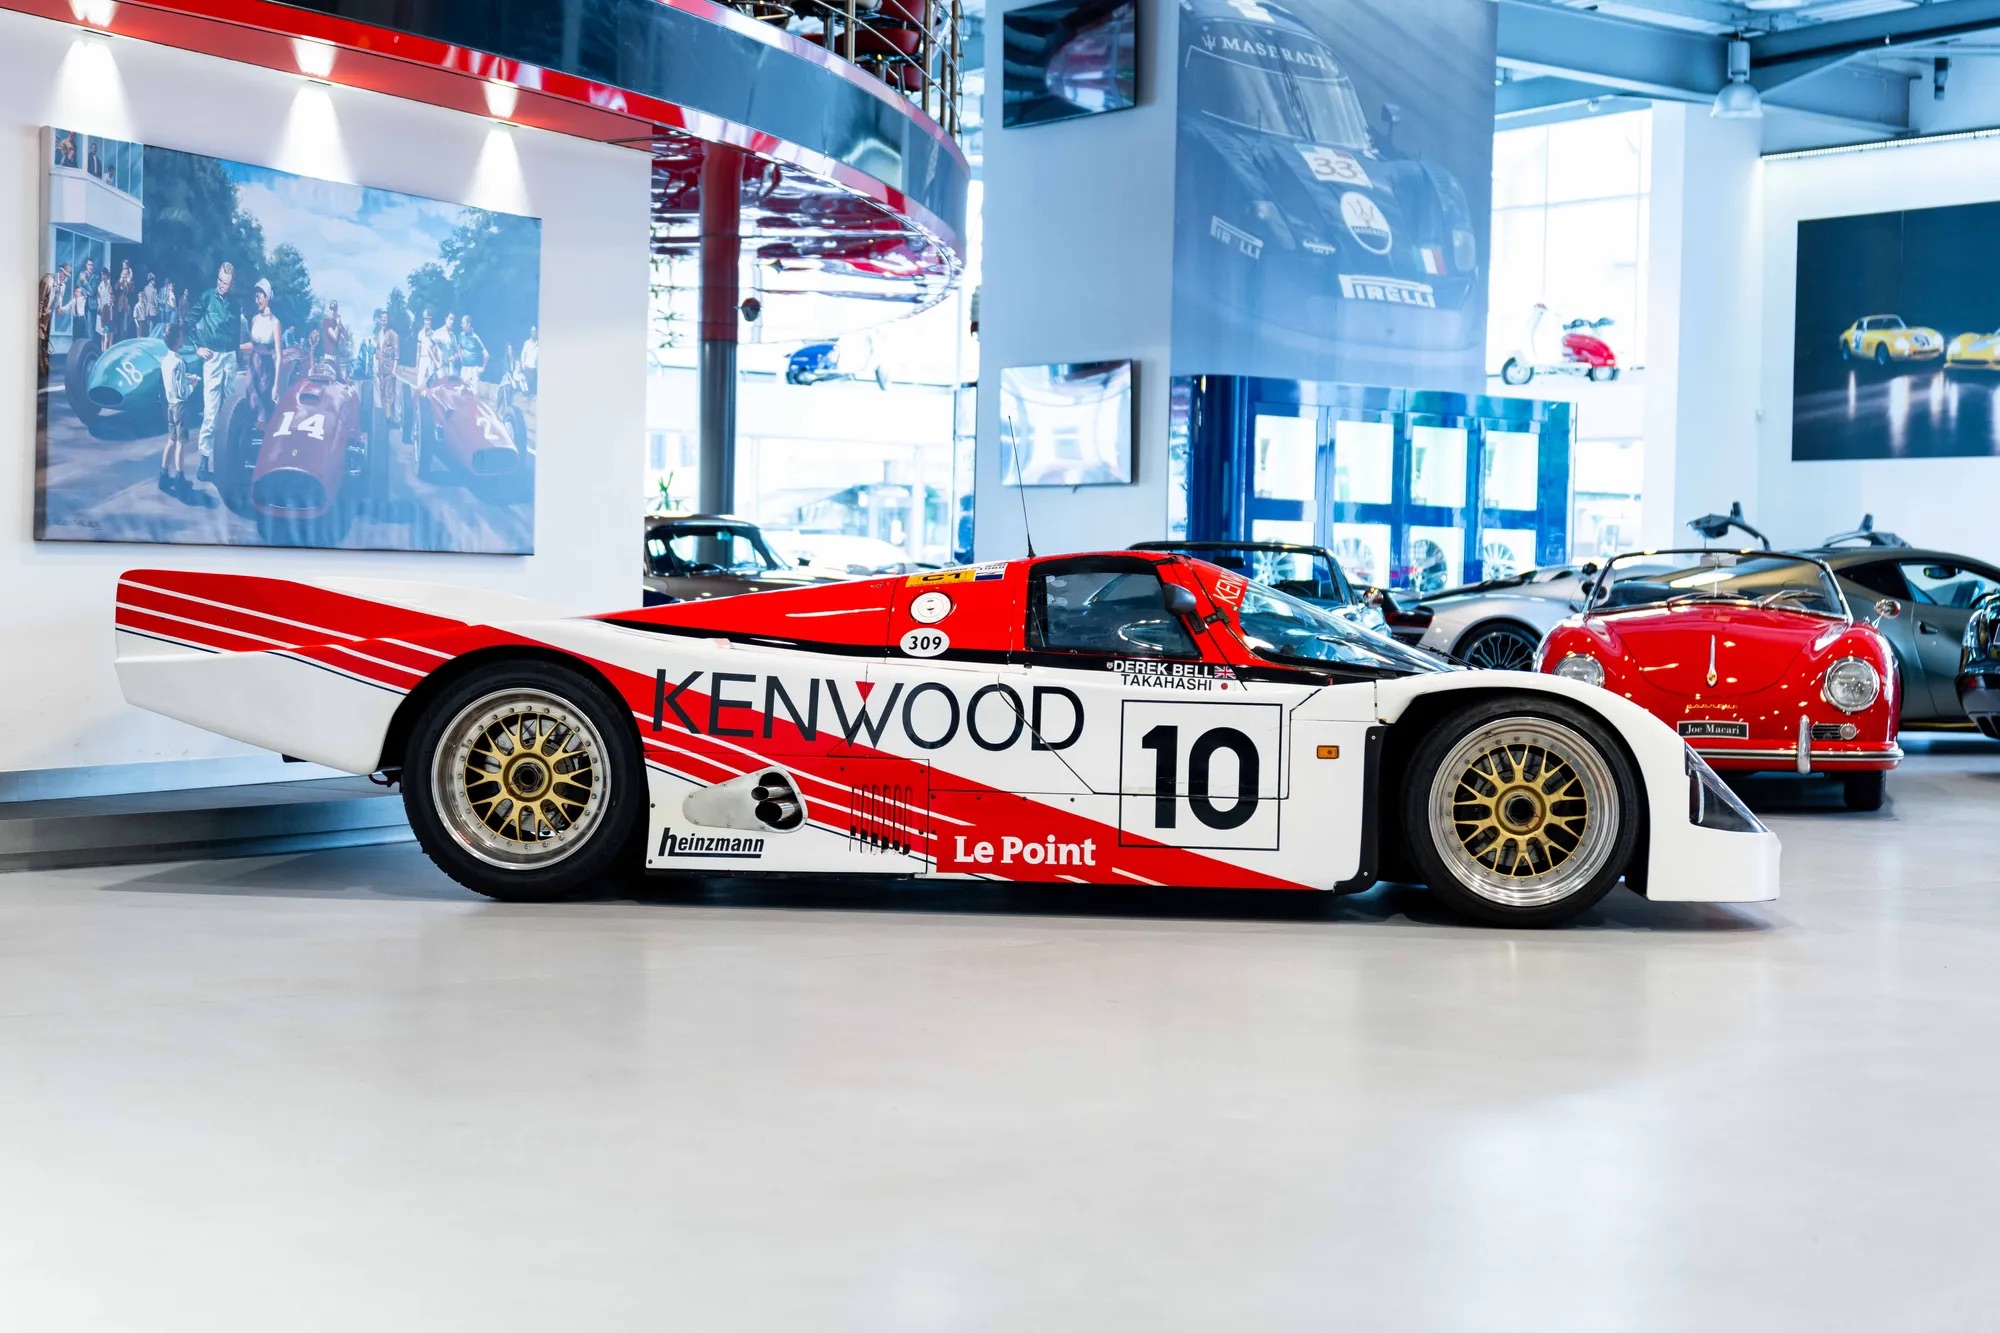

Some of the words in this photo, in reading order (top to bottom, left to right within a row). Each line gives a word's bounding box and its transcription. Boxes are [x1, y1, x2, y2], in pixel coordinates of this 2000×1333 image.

[1221, 36, 1327, 69] MASERATI
[1313, 157, 1358, 179] 33
[1338, 273, 1436, 308] PIRELLI
[115, 361, 143, 385] 18
[273, 411, 325, 441] 14
[908, 635, 942, 651] 309
[1113, 660, 1168, 675] DEREK
[1172, 664, 1213, 678] BELL
[1121, 674, 1212, 691] TAKAHASHI
[652, 668, 1085, 752] KENWOOD
[1686, 724, 1703, 734] Joe
[1705, 724, 1740, 735] Macari
[1141, 725, 1260, 830] 10
[658, 827, 765, 857] heinzmann
[954, 836, 994, 863] Le
[1001, 834, 1096, 866] Point
